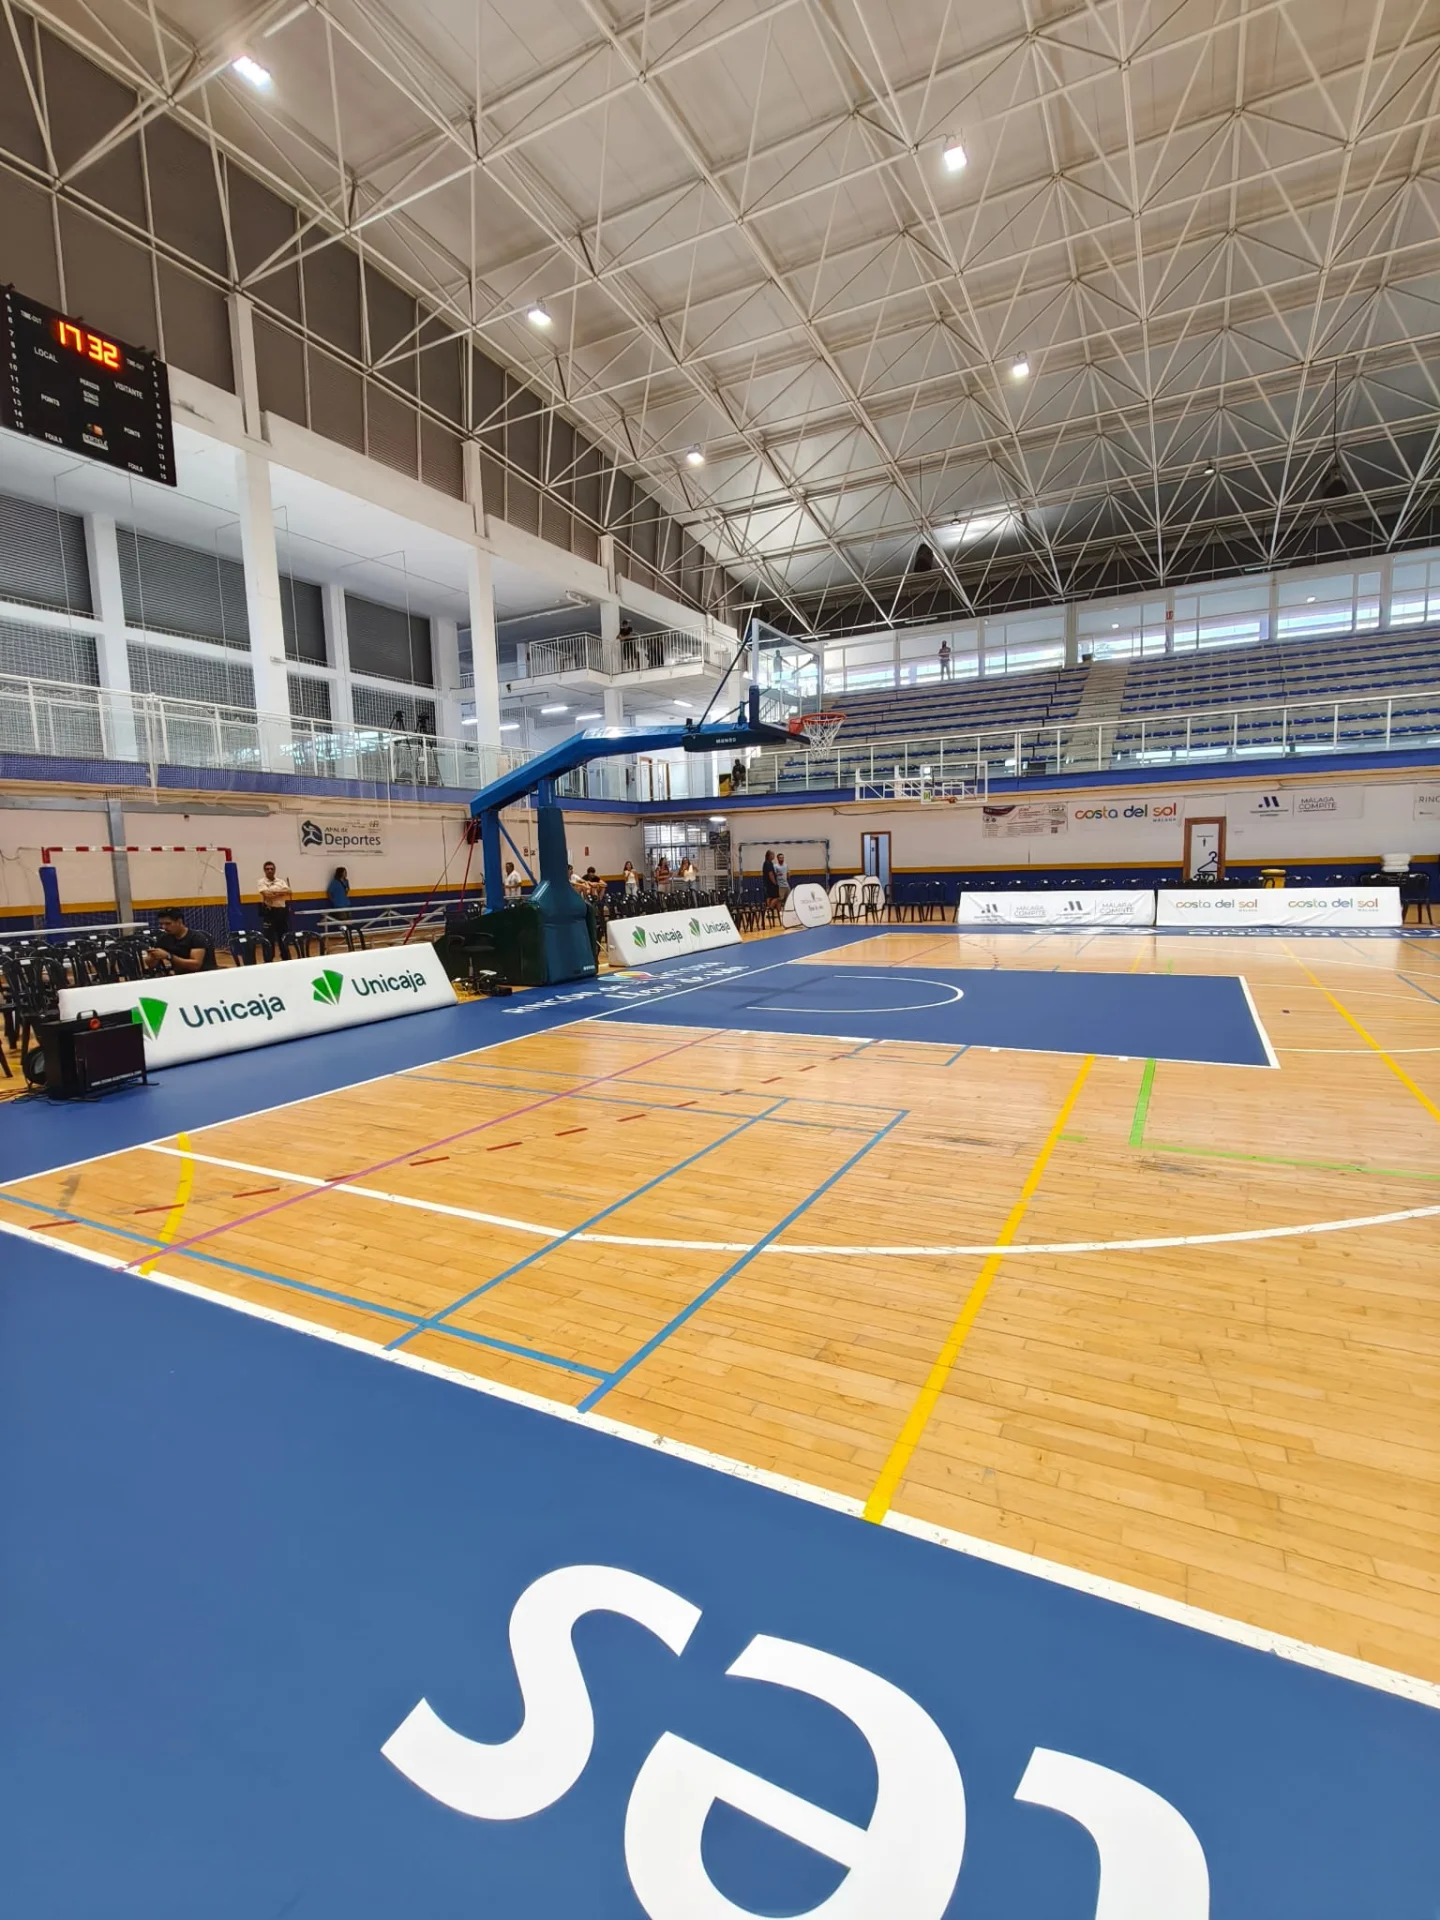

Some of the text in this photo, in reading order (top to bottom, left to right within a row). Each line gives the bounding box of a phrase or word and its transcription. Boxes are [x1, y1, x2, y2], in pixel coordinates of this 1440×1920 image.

[58, 320, 119, 369] 17 32
[33, 346, 59, 363] LOCAL
[113, 380, 144, 400] VISITANTE
[45, 432, 63, 444] FOULS
[127, 461, 143, 473] FOULS
[1074, 804, 1118, 820] costa
[1123, 804, 1148, 818] del
[1153, 802, 1176, 817] sol
[1298, 802, 1337, 810] COMPITE
[324, 833, 381, 849] Deportes
[1175, 899, 1258, 909] costa del sol
[1288, 898, 1379, 909] costa del sol
[702, 920, 731, 934] Unicaja
[649, 928, 684, 944] Unicaja
[352, 970, 427, 997] Unicaja
[179, 993, 286, 1029] Unicaja
